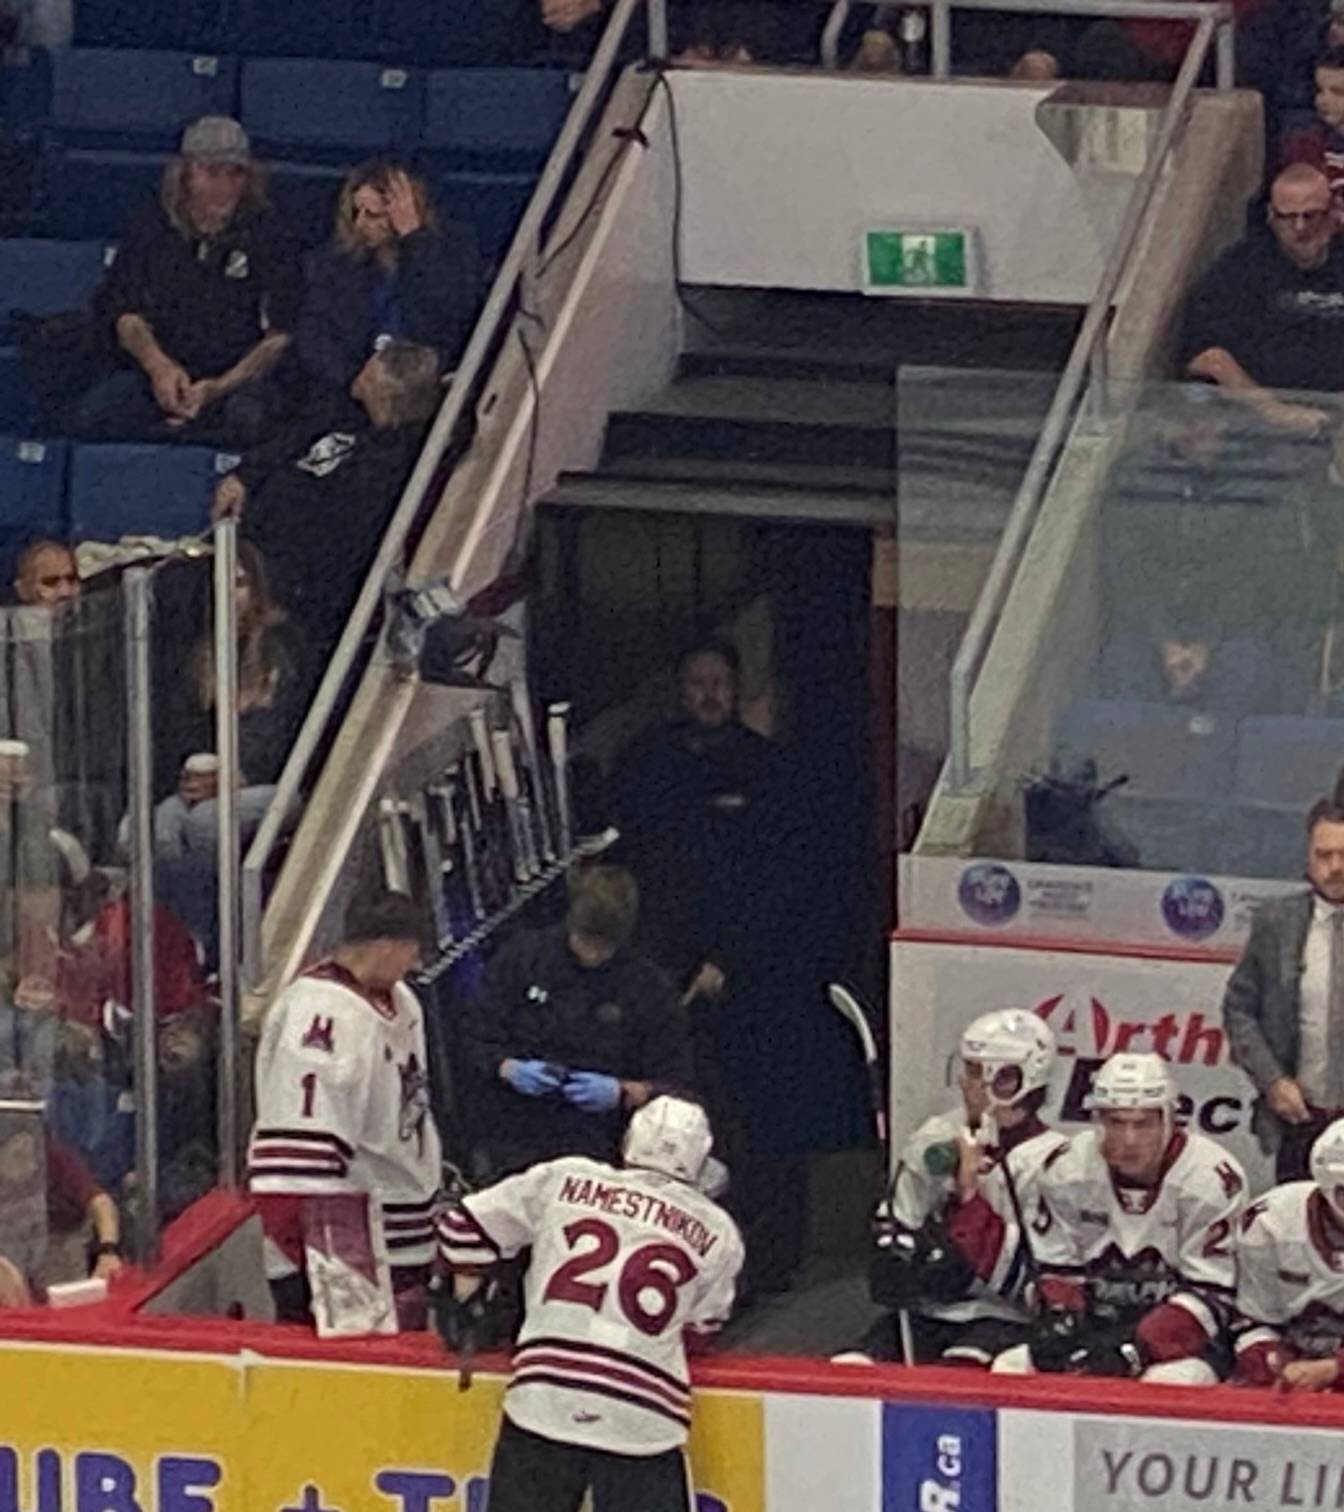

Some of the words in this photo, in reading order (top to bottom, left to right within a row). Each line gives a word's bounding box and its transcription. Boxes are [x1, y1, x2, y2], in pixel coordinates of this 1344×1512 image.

[1034, 992, 1226, 1067] Arth
[301, 1072, 317, 1119] 1
[558, 1175, 719, 1258] NAMESTNIKOV
[1202, 1218, 1231, 1259] 2
[541, 1216, 699, 1337] 26
[1101, 1450, 1259, 1502] YOUR
